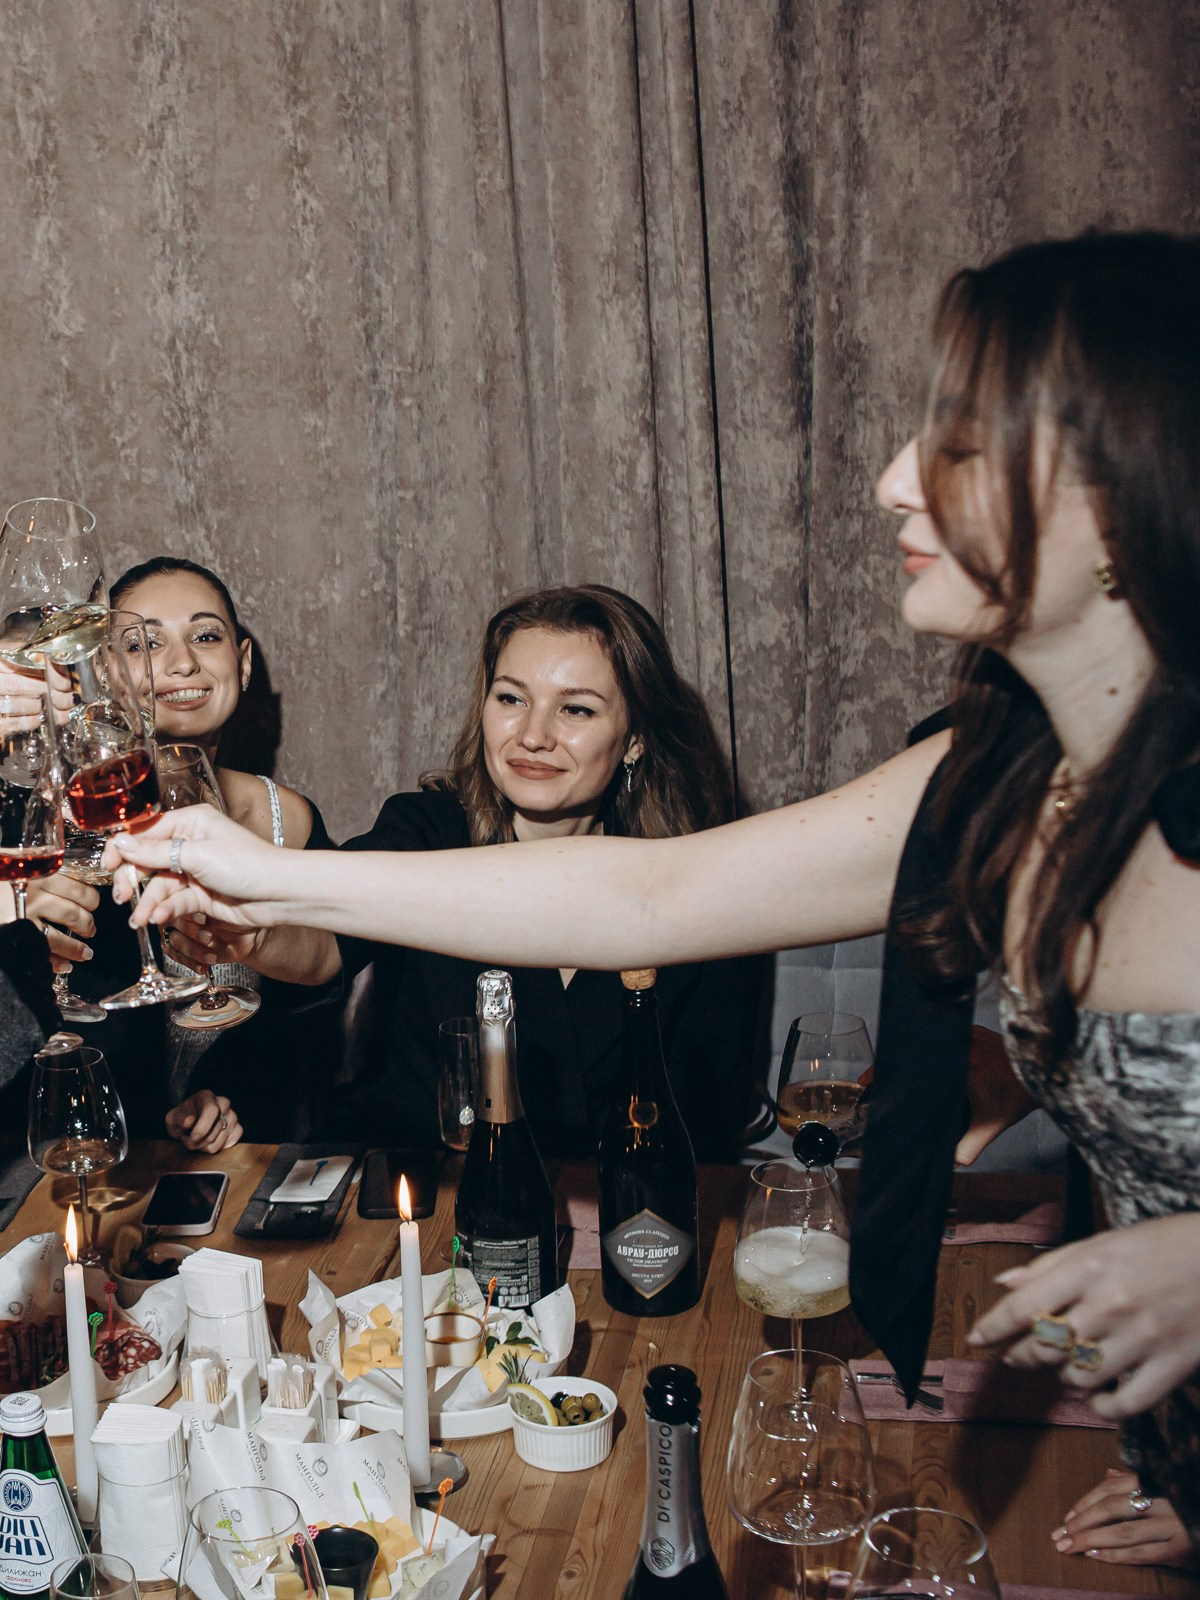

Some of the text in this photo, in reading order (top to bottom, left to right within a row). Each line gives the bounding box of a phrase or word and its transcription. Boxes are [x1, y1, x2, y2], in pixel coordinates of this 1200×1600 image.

[617, 1245, 679, 1259] АБРАУ-ДЮРСО
[294, 1452, 325, 1499] МАНГОЛЬД
[658, 1424, 673, 1501] CASPICO
[0, 1515, 40, 1537] DILI
